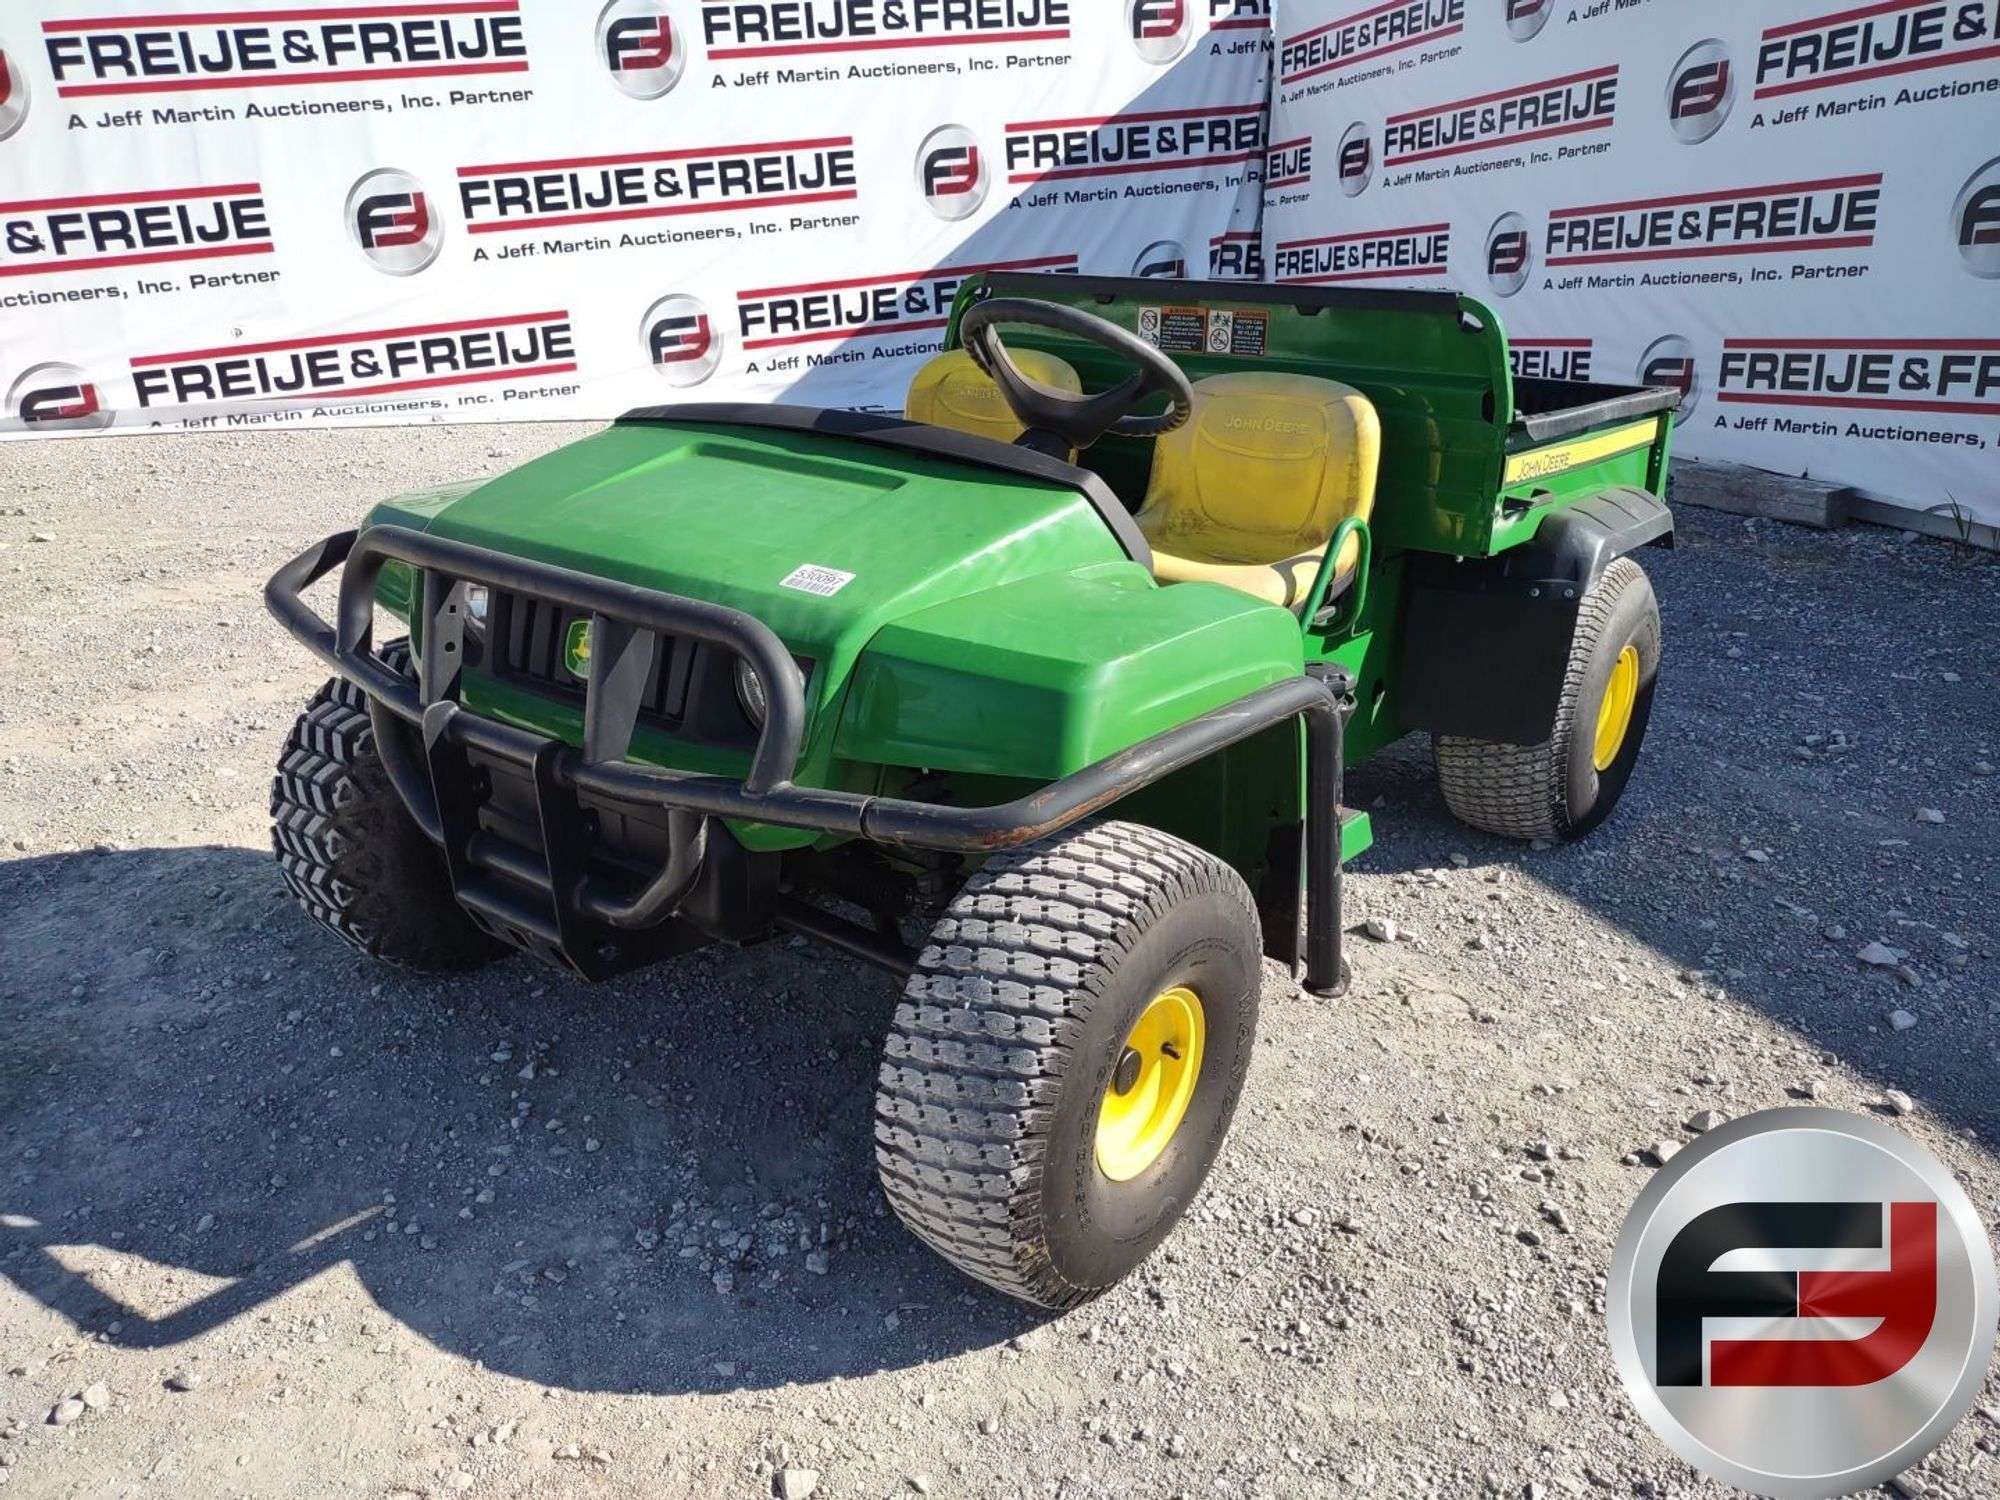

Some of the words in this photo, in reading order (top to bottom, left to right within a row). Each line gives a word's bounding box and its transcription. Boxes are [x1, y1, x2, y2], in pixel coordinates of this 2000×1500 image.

[1567, 10, 1577, 24] A
[1582, 1, 1608, 18] Jeff
[1210, 43, 1222, 55] A
[1227, 40, 1256, 54] Jeff
[712, 75, 726, 88] A
[734, 71, 769, 86] Jeff
[777, 67, 839, 83] Martin
[848, 63, 961, 78] Auctioneers,
[969, 58, 998, 70] Inc.
[1007, 56, 1071, 68] Partner
[1289, 89, 1304, 101] Jeff
[1307, 82, 1334, 96] Martin
[1337, 66, 1394, 88] Auctioneers,
[1399, 60, 1416, 70] Inc.
[1420, 46, 1462, 64] Partner
[68, 114, 87, 129] A
[96, 110, 142, 127] Jeff
[152, 106, 235, 124] Martin
[246, 100, 392, 118] Auctioneers,
[401, 95, 440, 108] Inc.
[450, 90, 533, 105] Partner
[1750, 114, 1764, 129] A
[1772, 106, 1809, 125] Jeff
[1816, 95, 1886, 118] Martin
[1894, 76, 2000, 105] Auctione
[1383, 177, 1390, 188] A
[1394, 173, 1412, 186] Jeff
[1415, 168, 1449, 183] Martin
[1453, 157, 1525, 176] Auctioneers,
[1531, 152, 1552, 164] Inc.
[1558, 143, 1611, 159] Partner
[1009, 197, 1022, 209] A
[1028, 192, 1058, 207] Jeff
[1064, 187, 1118, 204] Martin
[1124, 181, 1219, 198] Auctioneers,
[474, 248, 489, 261] A
[497, 243, 536, 260] Jeff
[543, 237, 611, 254] Martin
[620, 228, 741, 247] Auctioneers,
[750, 223, 781, 234] Inc.
[790, 216, 859, 230] Partner
[0, 284, 129, 308] ctioneers,
[138, 281, 180, 294] Inc.
[190, 271, 280, 289] Partner
[1543, 278, 1553, 290] A
[1558, 277, 1583, 289] Jeff
[1587, 274, 1634, 288] Martin
[1640, 271, 1742, 286] Auctioneers,
[1751, 267, 1782, 281] Inc.
[1791, 265, 1869, 279] Partner
[746, 362, 759, 373] A
[767, 356, 799, 371] Jeff
[807, 350, 865, 366] Martin
[872, 338, 945, 359] Auctione
[502, 385, 581, 402] Partner
[1714, 415, 1727, 428] A
[1734, 416, 1768, 431] Jeff
[1774, 418, 1837, 436] Martin
[1845, 423, 1985, 449] Auctioneers,
[1517, 457, 1542, 479] JOHN
[1542, 452, 1571, 472] DEERE
